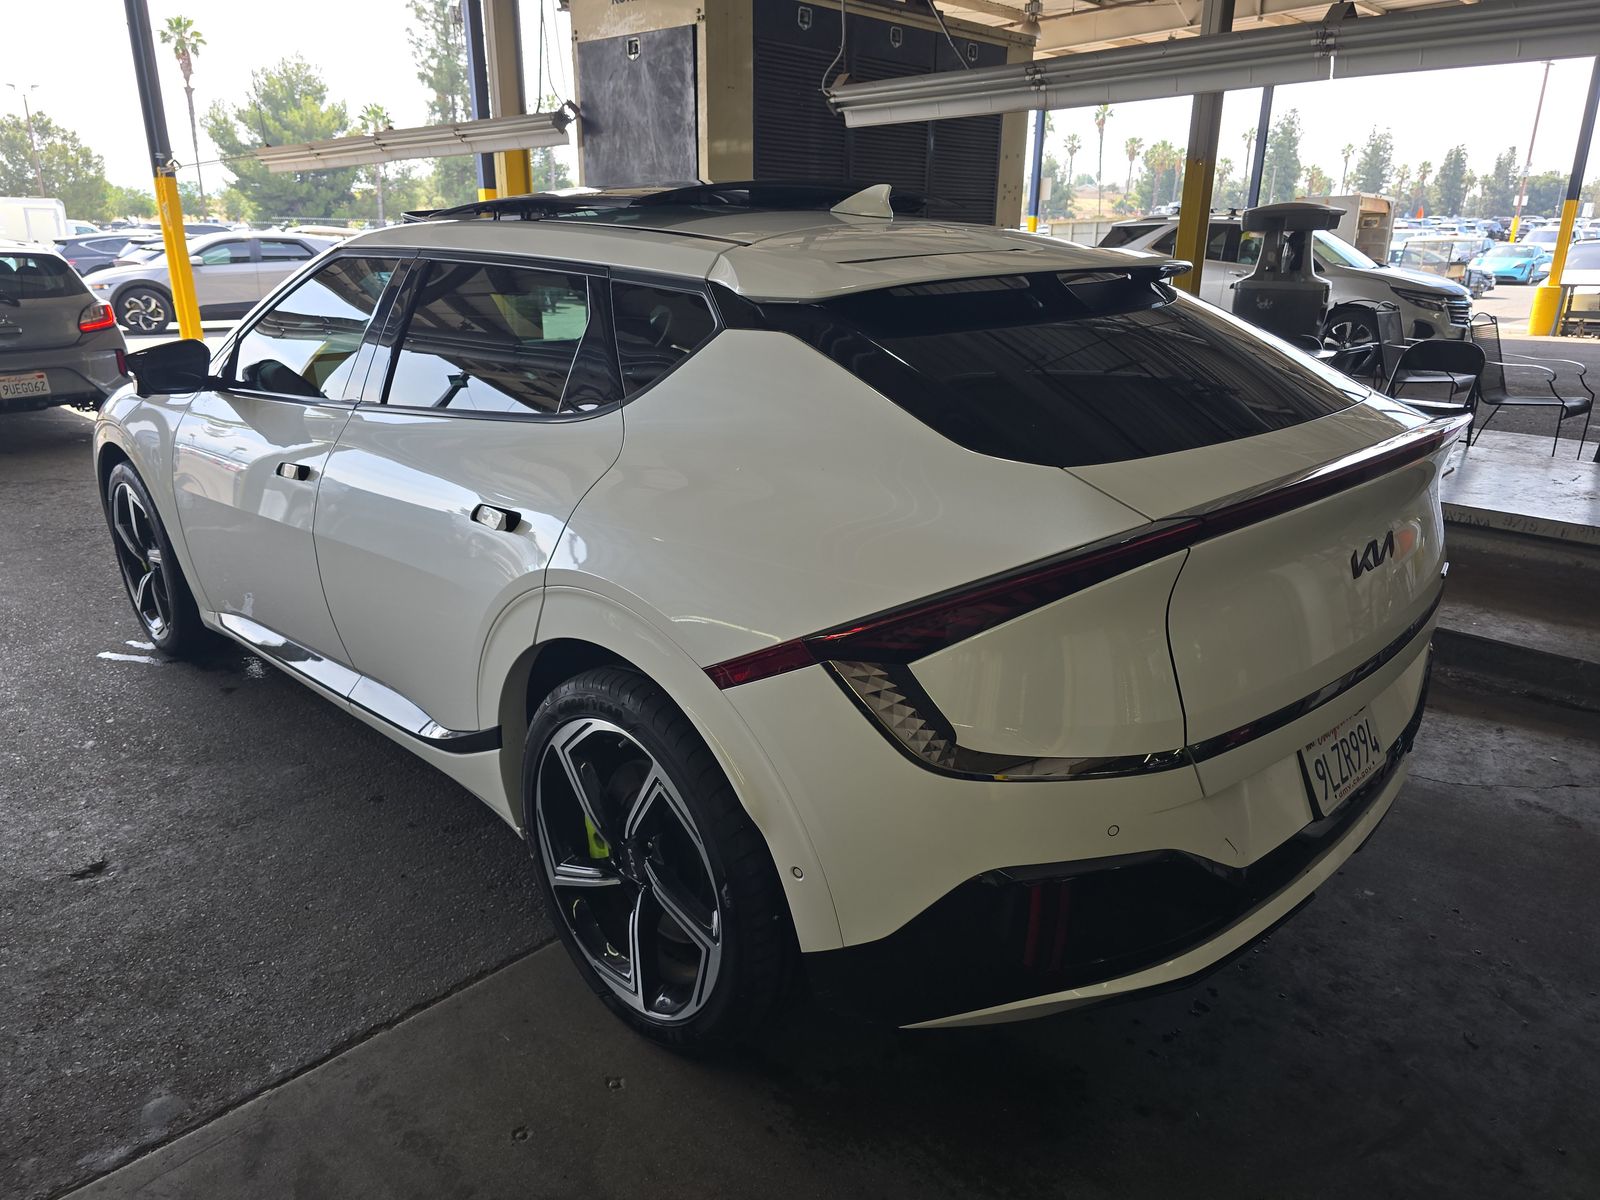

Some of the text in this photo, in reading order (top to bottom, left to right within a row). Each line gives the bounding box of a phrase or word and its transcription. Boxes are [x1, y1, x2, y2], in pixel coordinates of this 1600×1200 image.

[1351, 530, 1395, 580] KIA
[1314, 718, 1380, 801] 9LZR994
[1338, 764, 1372, 799] dmv.ca.gov
